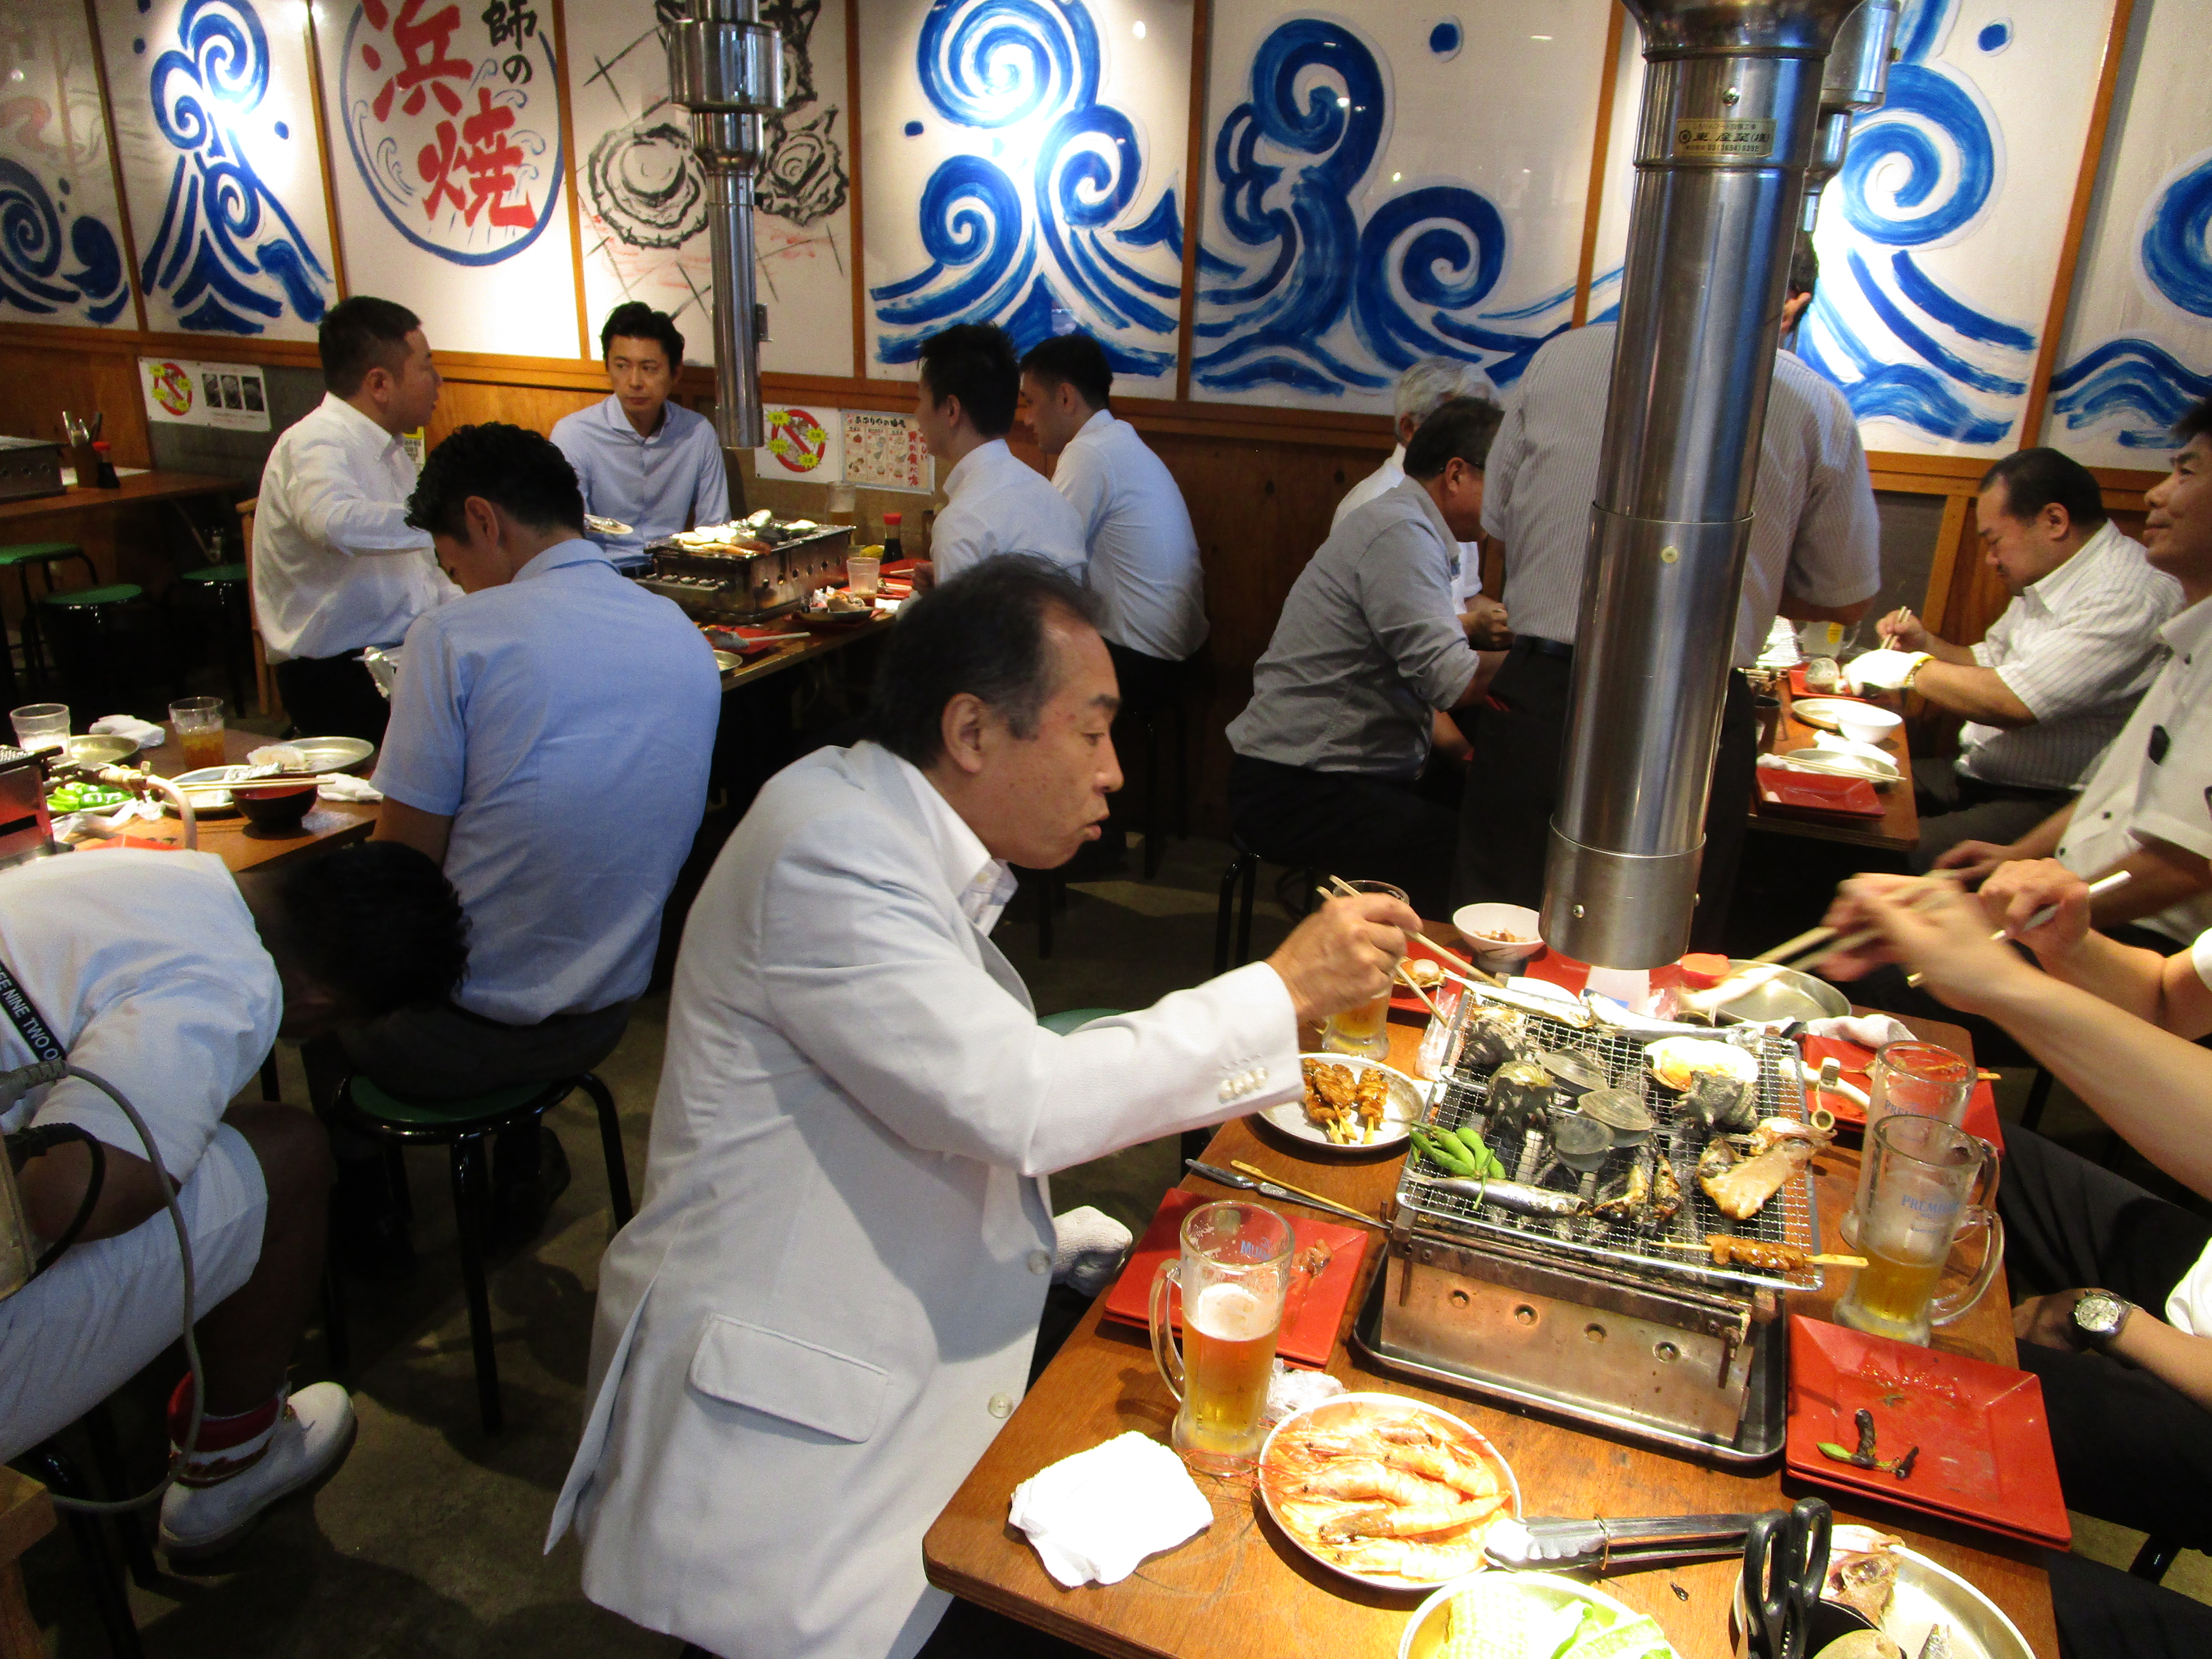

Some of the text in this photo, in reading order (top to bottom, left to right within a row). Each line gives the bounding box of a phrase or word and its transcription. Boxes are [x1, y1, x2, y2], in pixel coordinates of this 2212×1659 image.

[361, 0, 537, 228] 浜焼
[2, 988, 31, 1018] NINE
[22, 1017, 51, 1048] TWO
